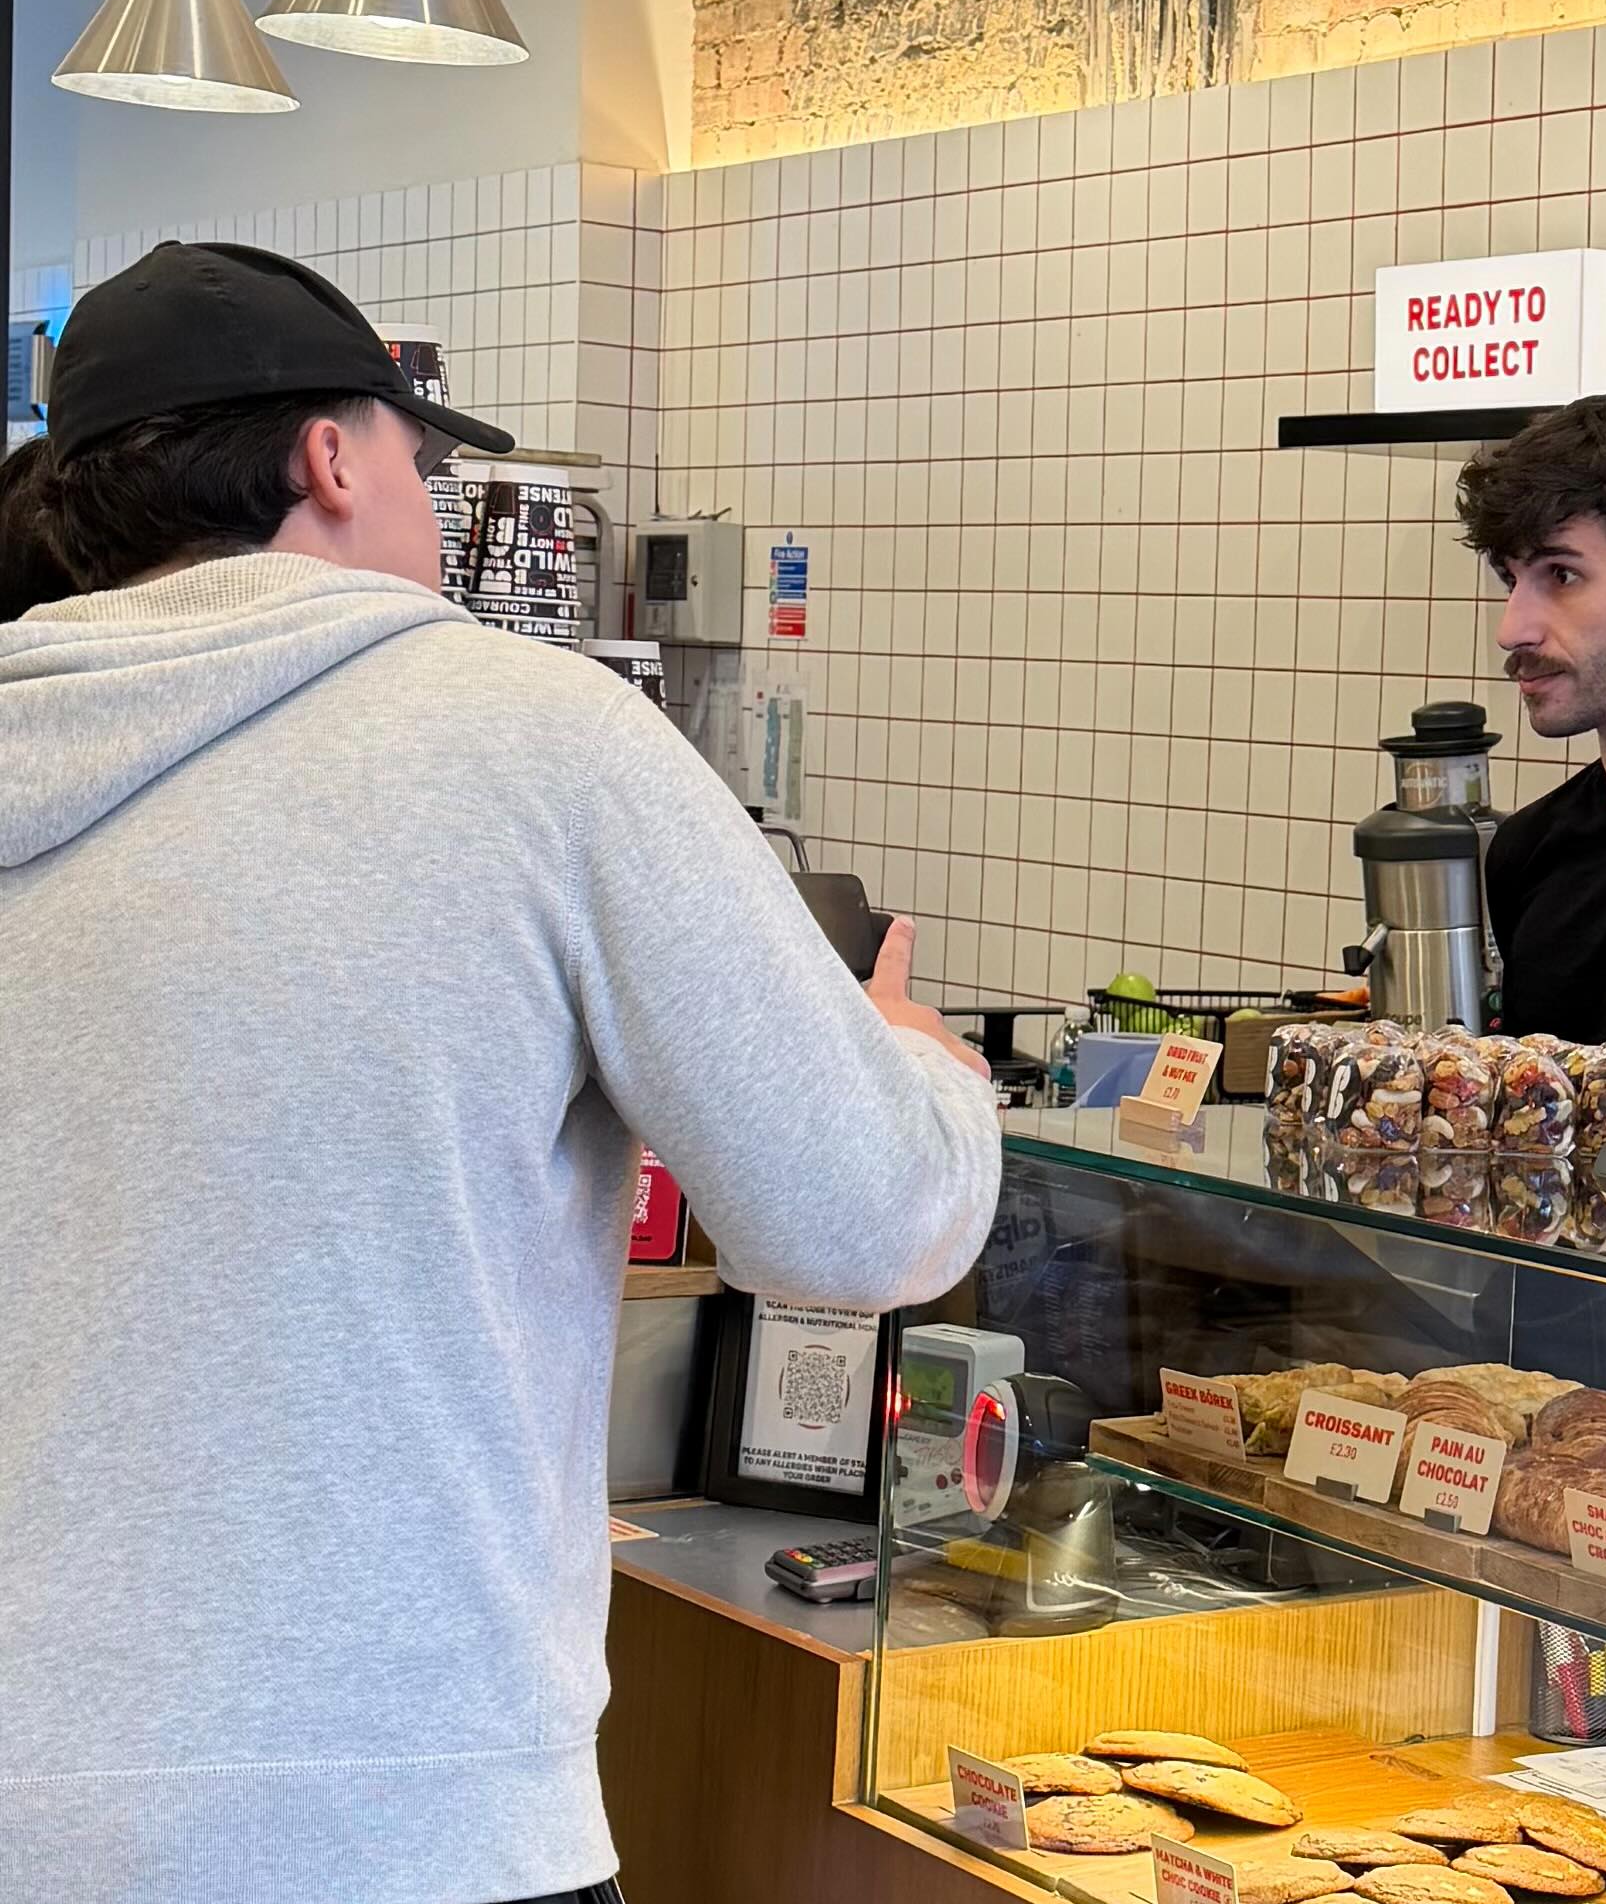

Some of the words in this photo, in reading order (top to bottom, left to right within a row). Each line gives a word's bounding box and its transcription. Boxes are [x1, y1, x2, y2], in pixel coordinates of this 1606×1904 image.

[1407, 289, 1502, 332] READY
[1507, 286, 1546, 324] TO
[1413, 339, 1539, 382] COLLECT
[514, 549, 572, 571] WILD
[1165, 1381, 1200, 1402] GREEK
[1304, 1410, 1395, 1446] CROISSANT
[1431, 1435, 1464, 1460] PAIN
[1464, 1444, 1486, 1465] AU
[1417, 1460, 1489, 1494] CHOCOLAT
[1572, 1520, 1604, 1541] CHOC
[956, 1763, 1018, 1803] CHOCOLATE
[970, 1790, 1009, 1820] COOKIE
[1155, 1846, 1194, 1876] MATCHA
[1203, 1865, 1234, 1891] WHITE
[1161, 1868, 1187, 1890] CHOC
[1187, 1877, 1222, 1904] COOKIE
